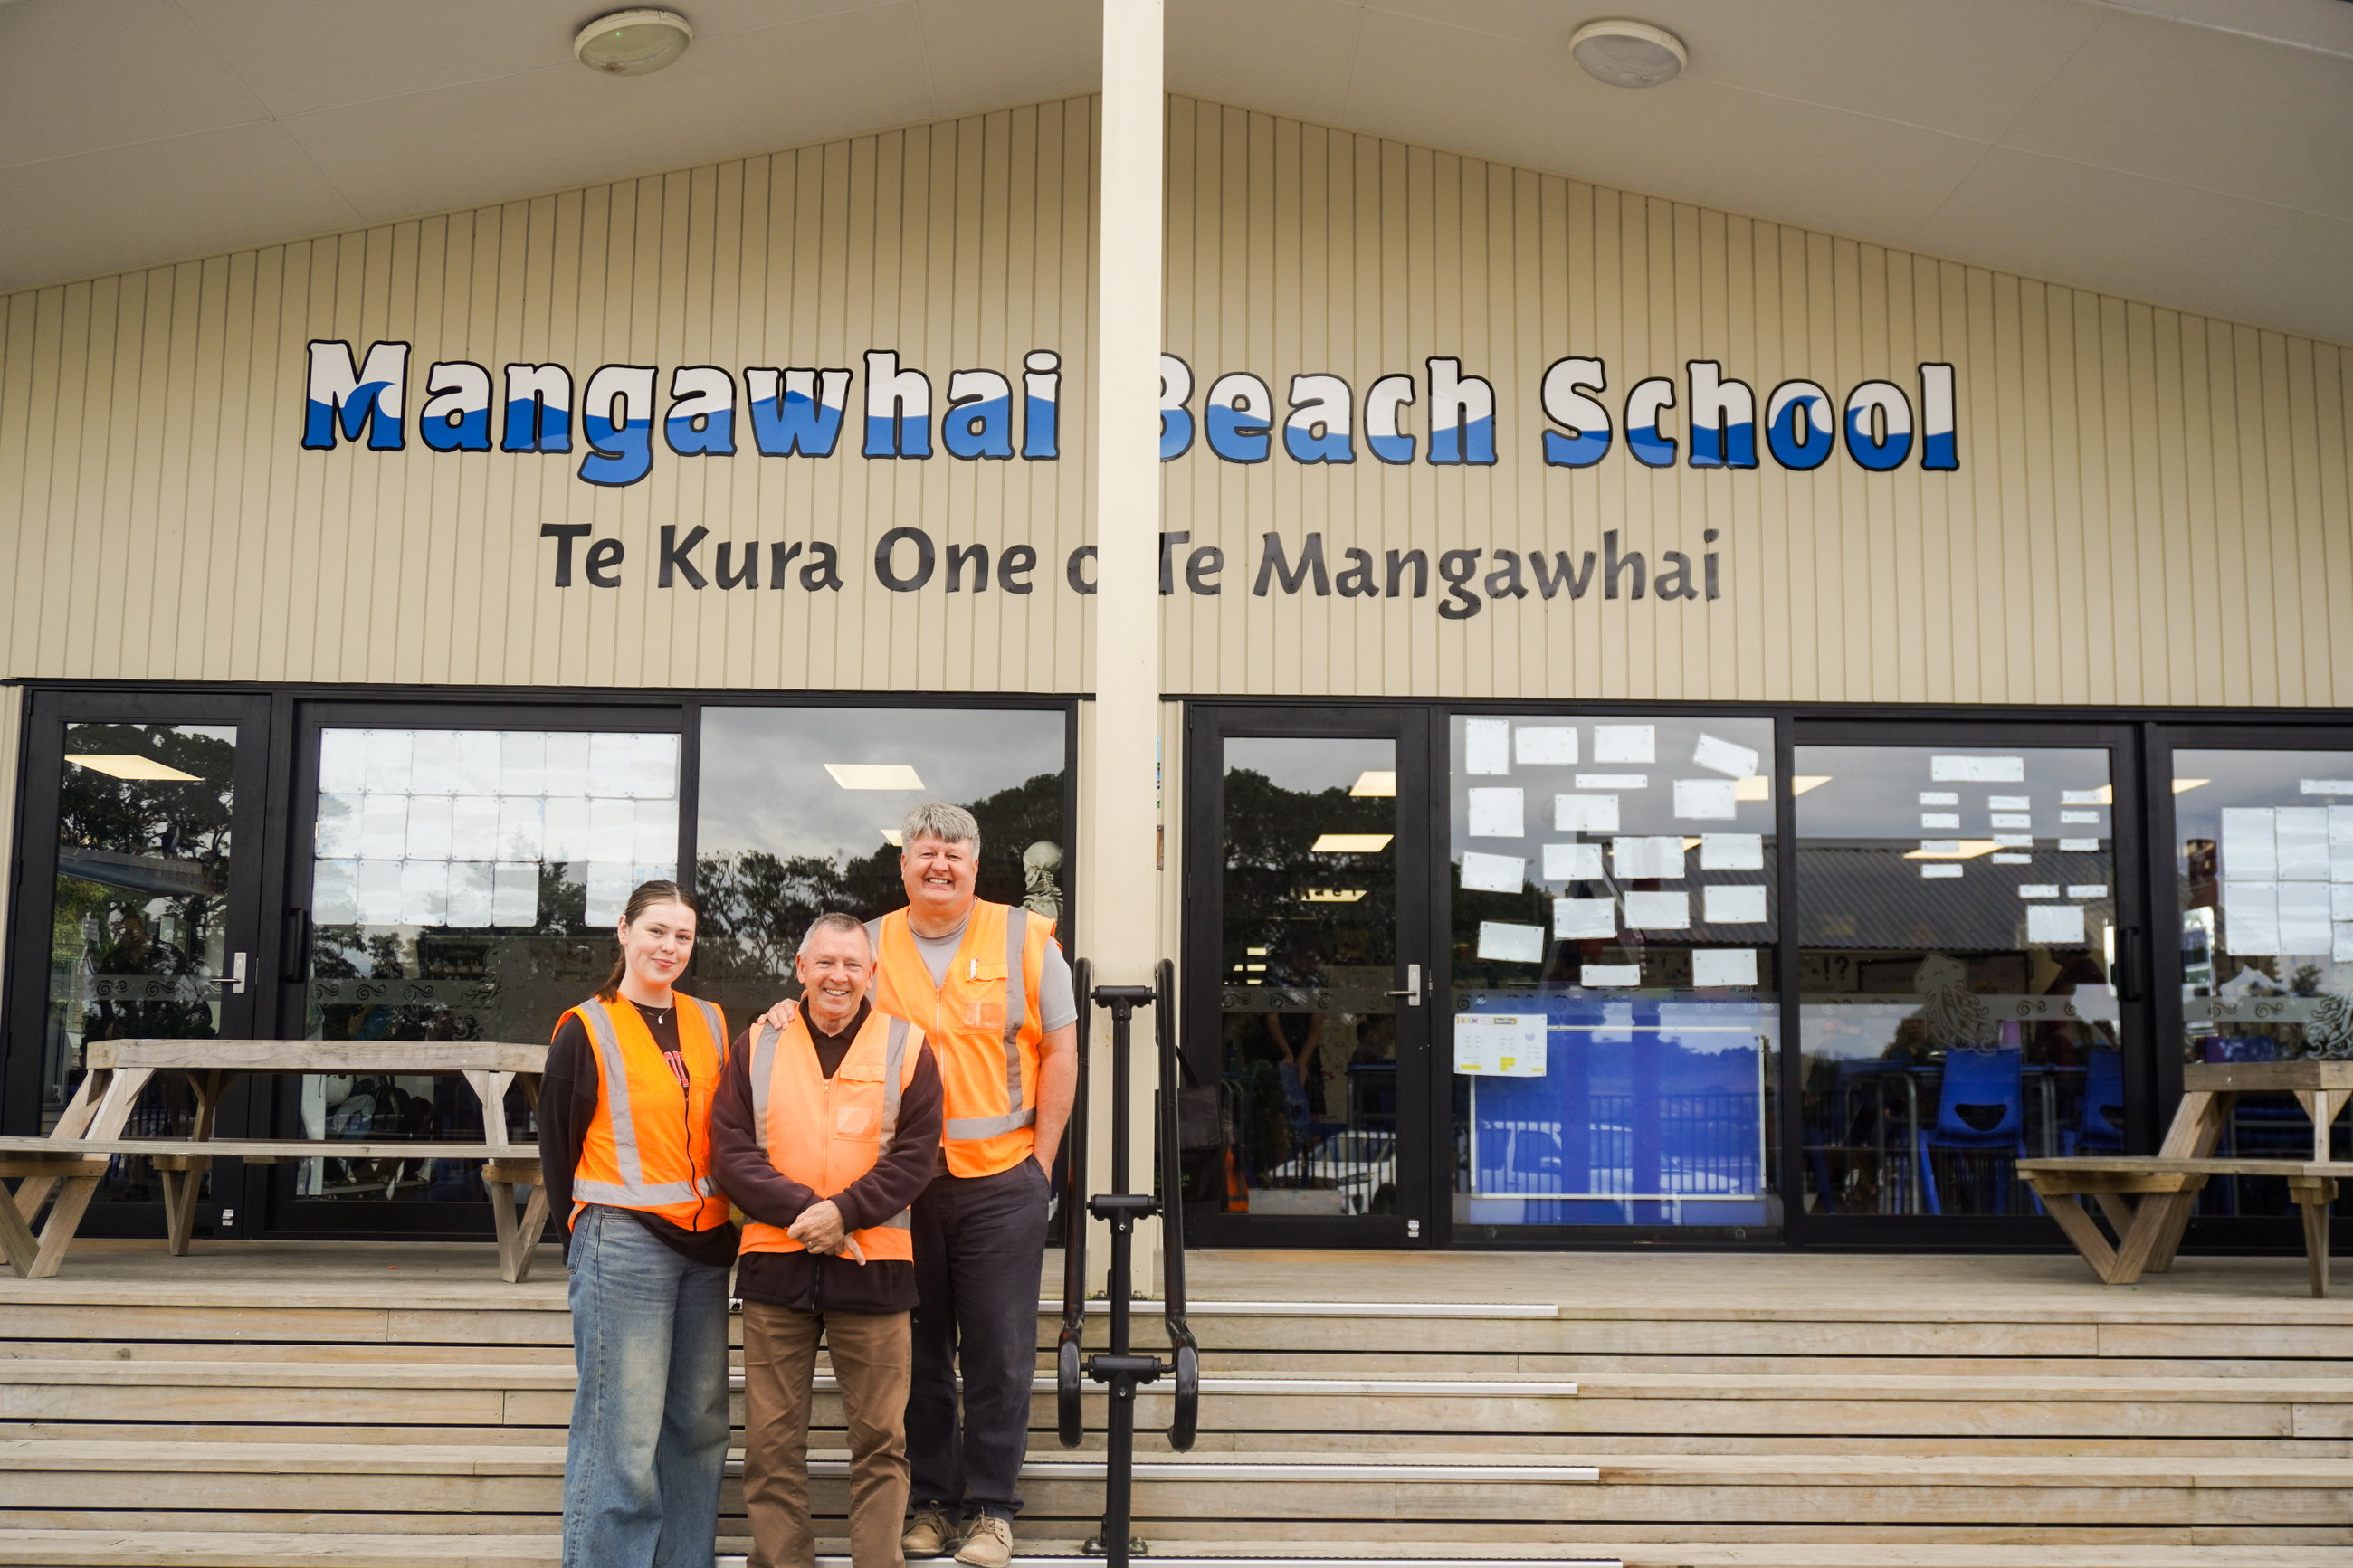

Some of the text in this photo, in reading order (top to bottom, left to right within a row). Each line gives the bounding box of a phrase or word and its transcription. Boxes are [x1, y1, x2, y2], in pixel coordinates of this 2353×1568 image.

[301, 339, 1062, 488] Mangawhai
[1540, 356, 1960, 472] School
[540, 524, 624, 590] Te
[658, 525, 844, 592] Kura
[875, 527, 1037, 594] One
[1159, 530, 1223, 595] Te
[1253, 529, 1720, 619] Mangawhai
